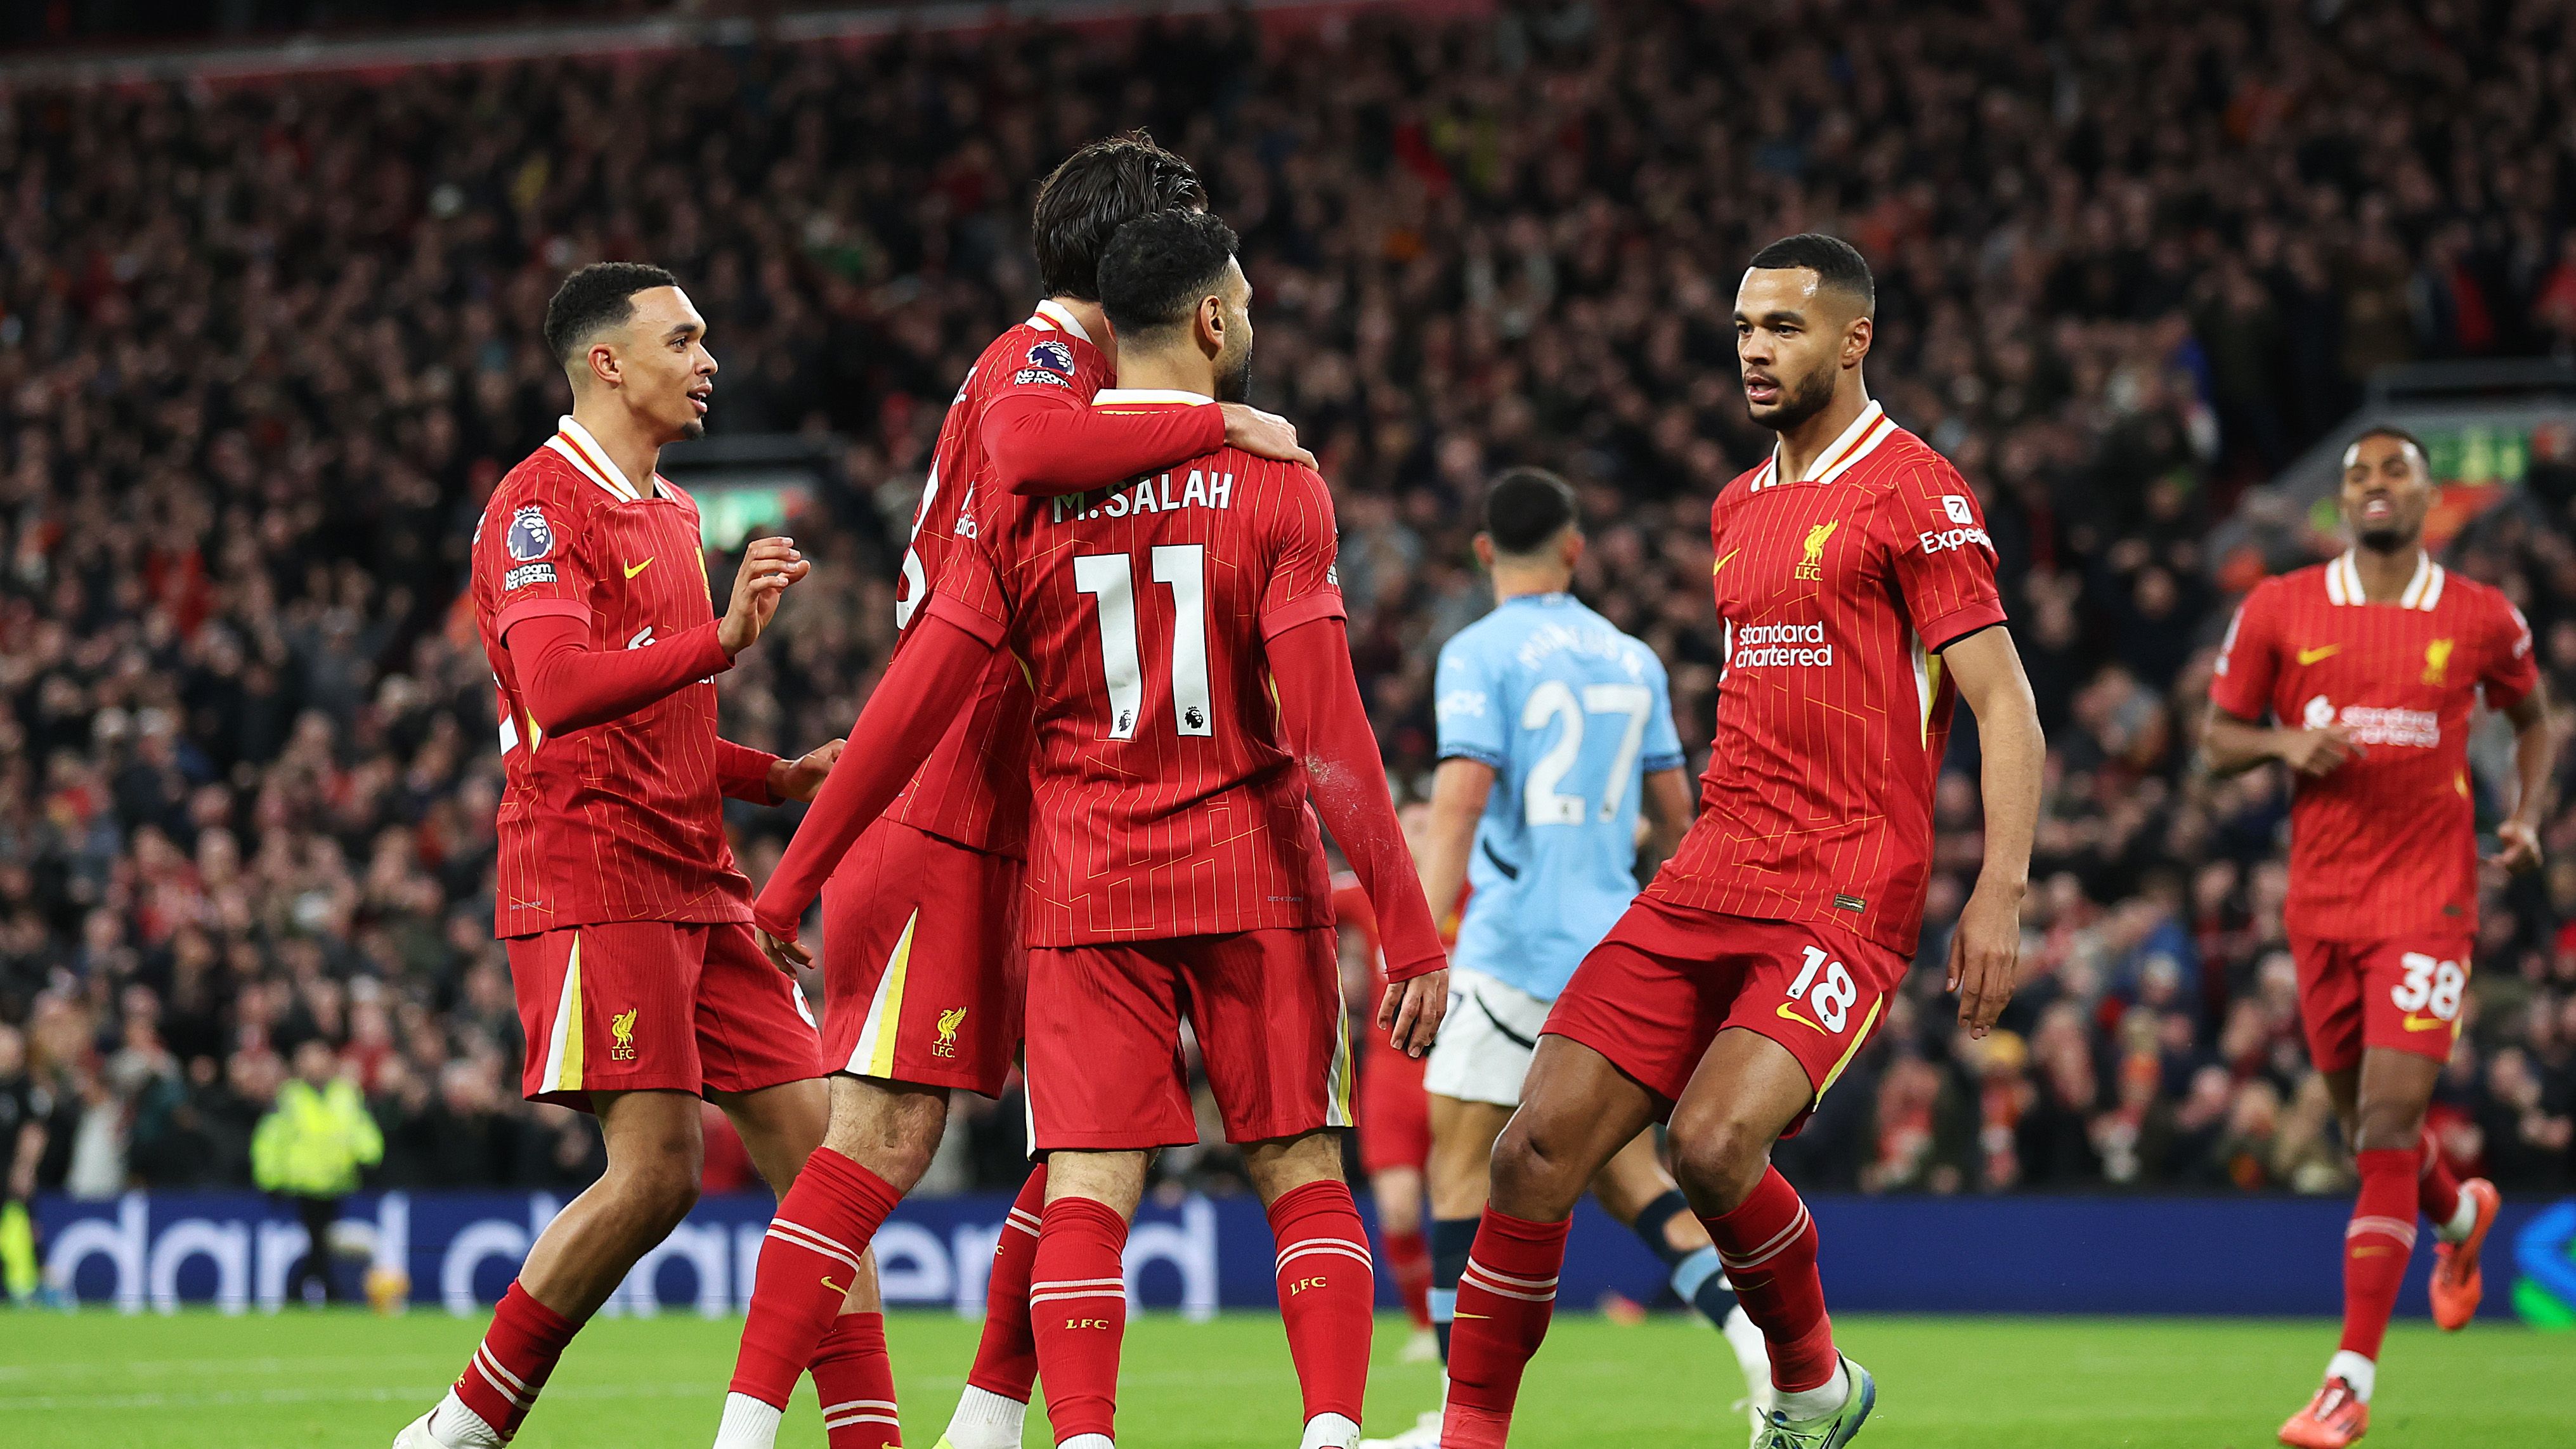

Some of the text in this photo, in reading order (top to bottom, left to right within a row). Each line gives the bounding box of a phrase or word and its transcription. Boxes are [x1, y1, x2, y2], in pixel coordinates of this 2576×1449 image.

[1015, 370, 1035, 379] No
[1036, 371, 1069, 387] room
[1054, 469, 1233, 523] M.SALAH
[505, 564, 552, 582] No room
[519, 573, 557, 586] racism
[1073, 543, 1212, 739] 11
[1739, 620, 1824, 646] standard
[1735, 644, 1833, 668] chartered
[1523, 680, 1653, 826] 27
[1785, 945, 1857, 1034] 18
[2390, 951, 2466, 1022] 38
[1290, 1277, 1327, 1297] LFC
[1065, 1318, 1109, 1330] LFC
